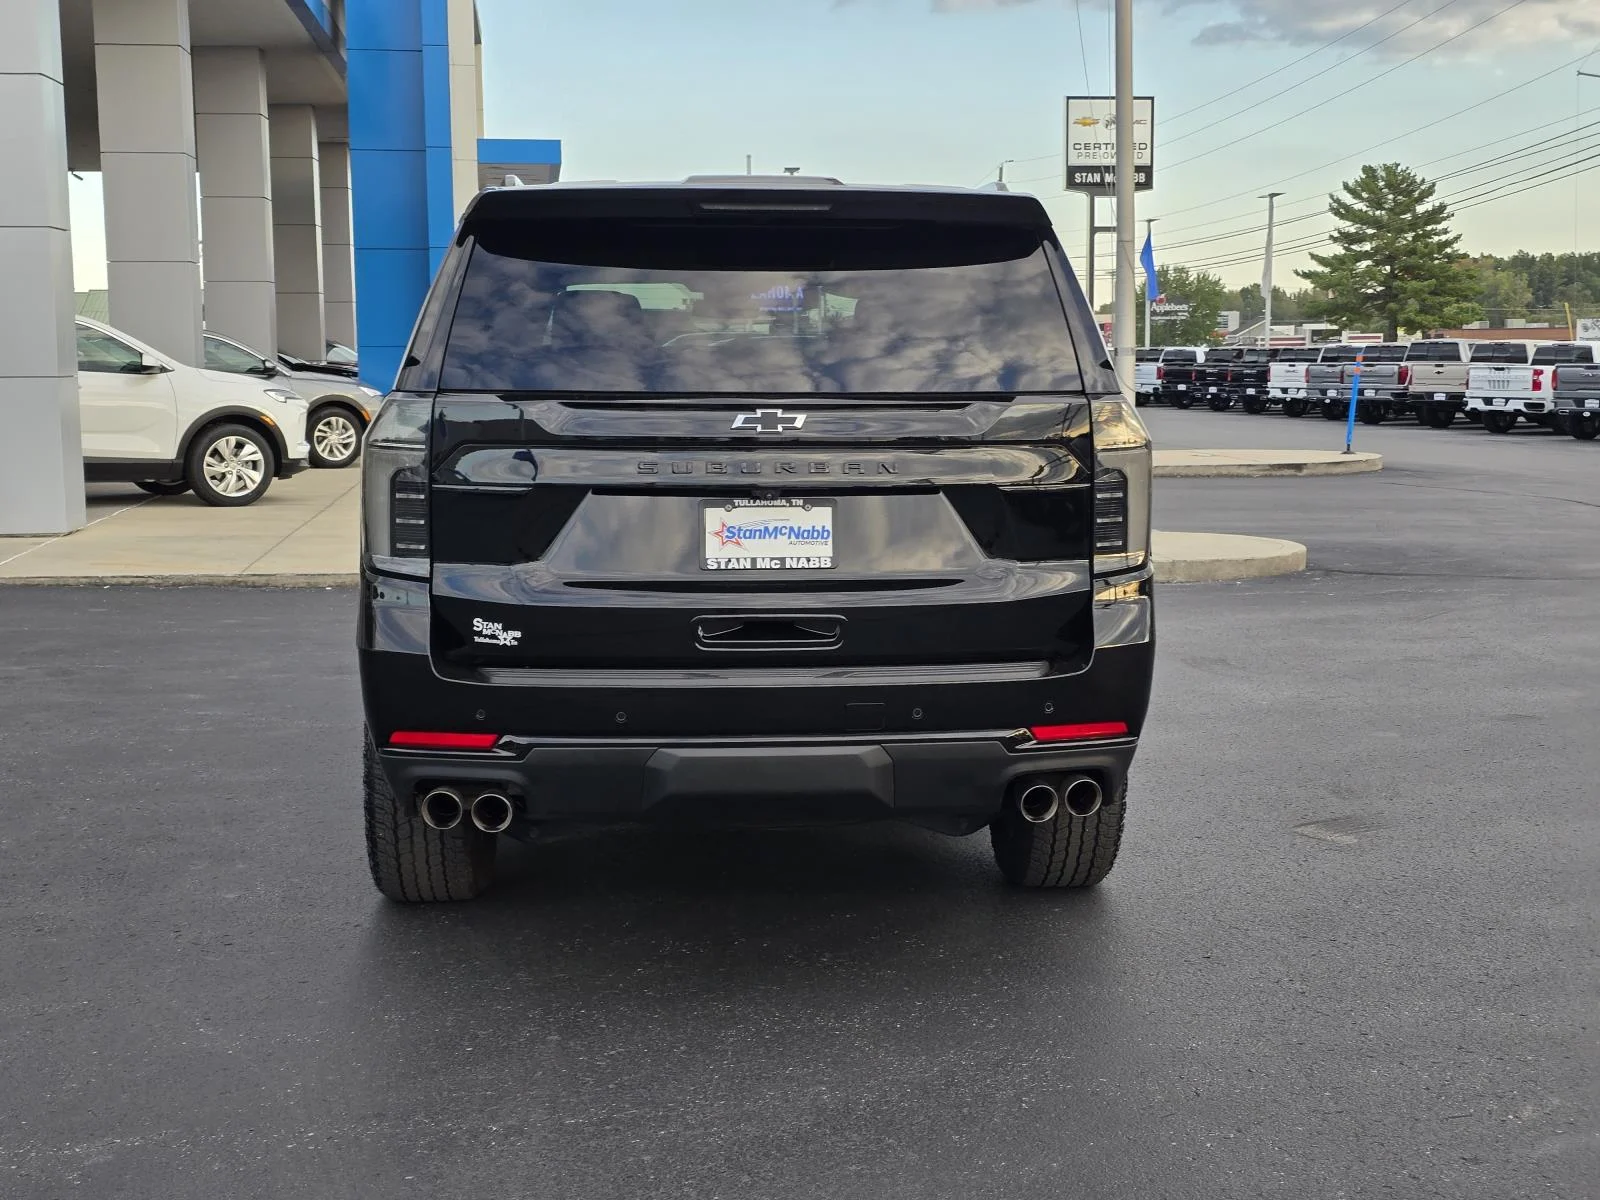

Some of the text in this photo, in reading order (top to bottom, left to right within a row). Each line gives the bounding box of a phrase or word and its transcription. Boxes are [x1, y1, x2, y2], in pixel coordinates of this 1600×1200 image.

[1074, 173, 1100, 182] STAN
[637, 462, 899, 474] SUBURBAN
[791, 499, 804, 507] TN
[706, 557, 832, 569] STAN Mc NABB
